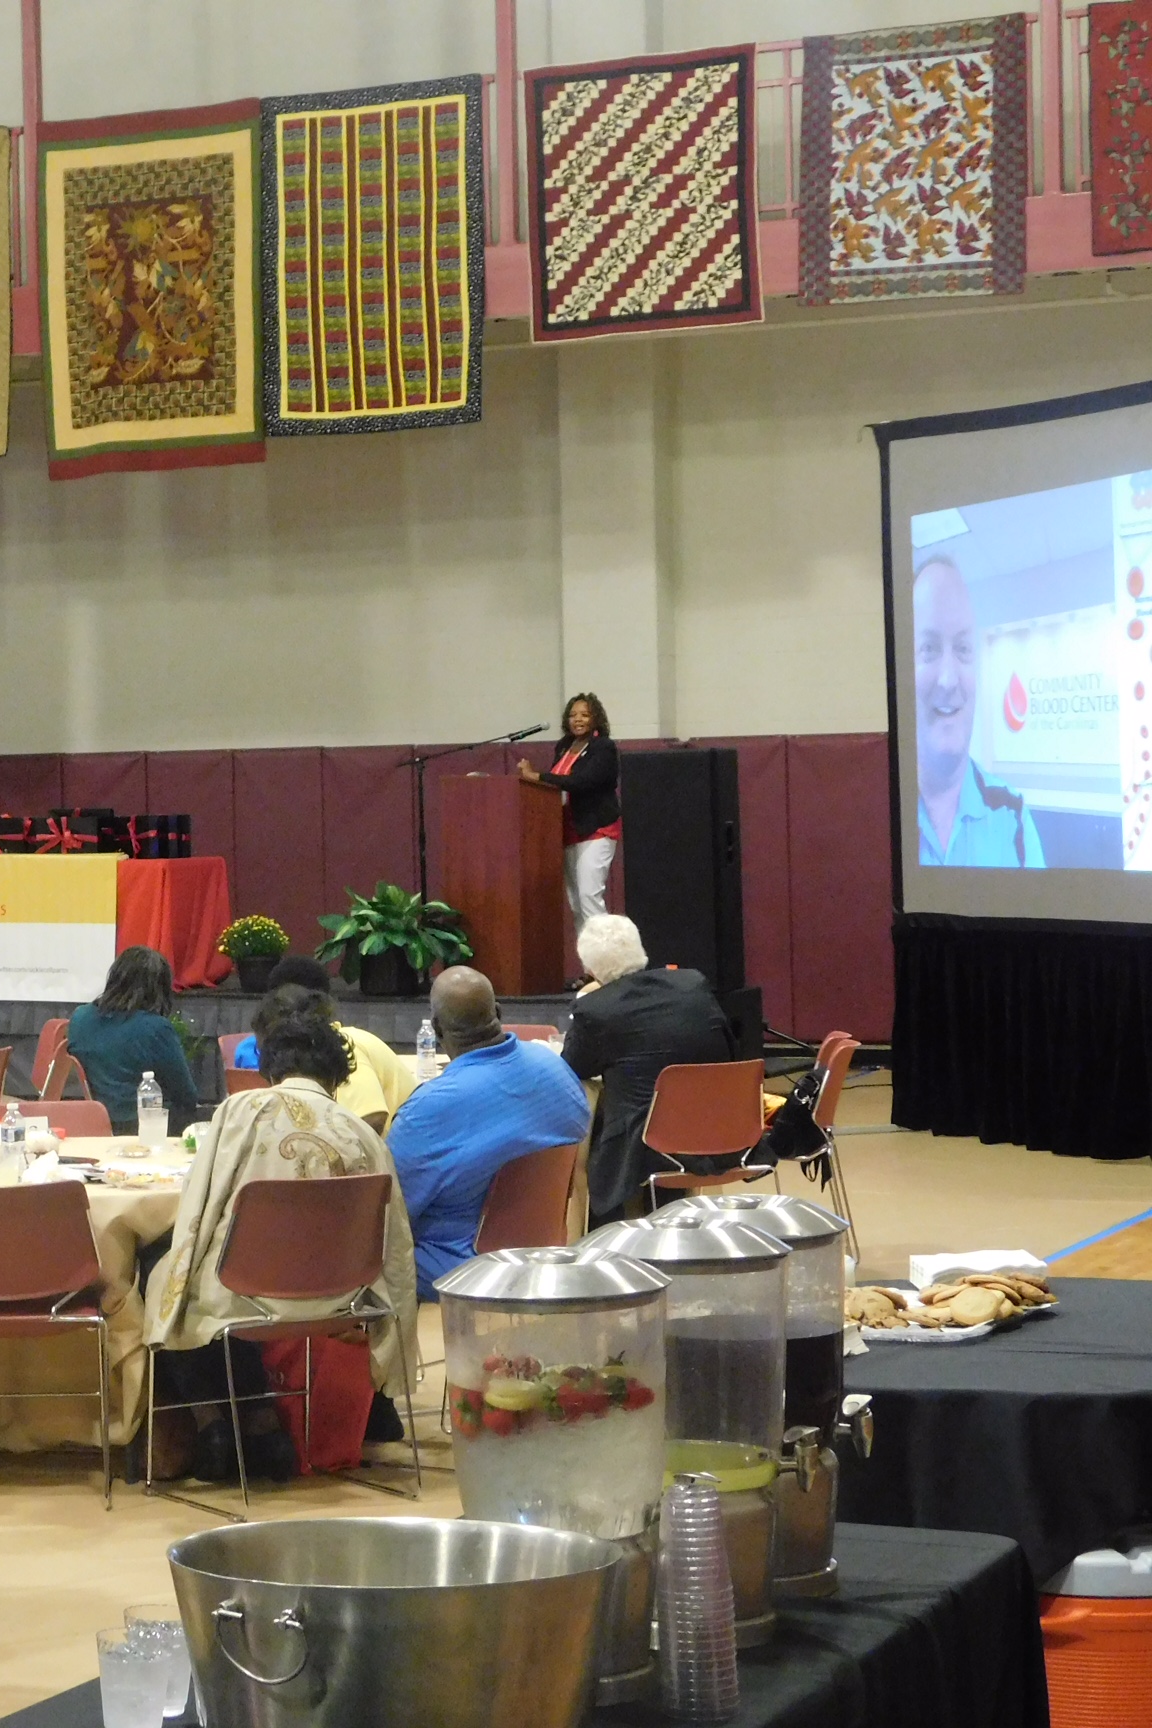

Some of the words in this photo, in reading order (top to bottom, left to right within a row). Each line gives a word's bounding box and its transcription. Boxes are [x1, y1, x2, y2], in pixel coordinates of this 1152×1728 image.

[1029, 674, 1101, 694] COMMUNITY
[1030, 697, 1069, 715] BLOOD
[1070, 695, 1119, 713] CENTER
